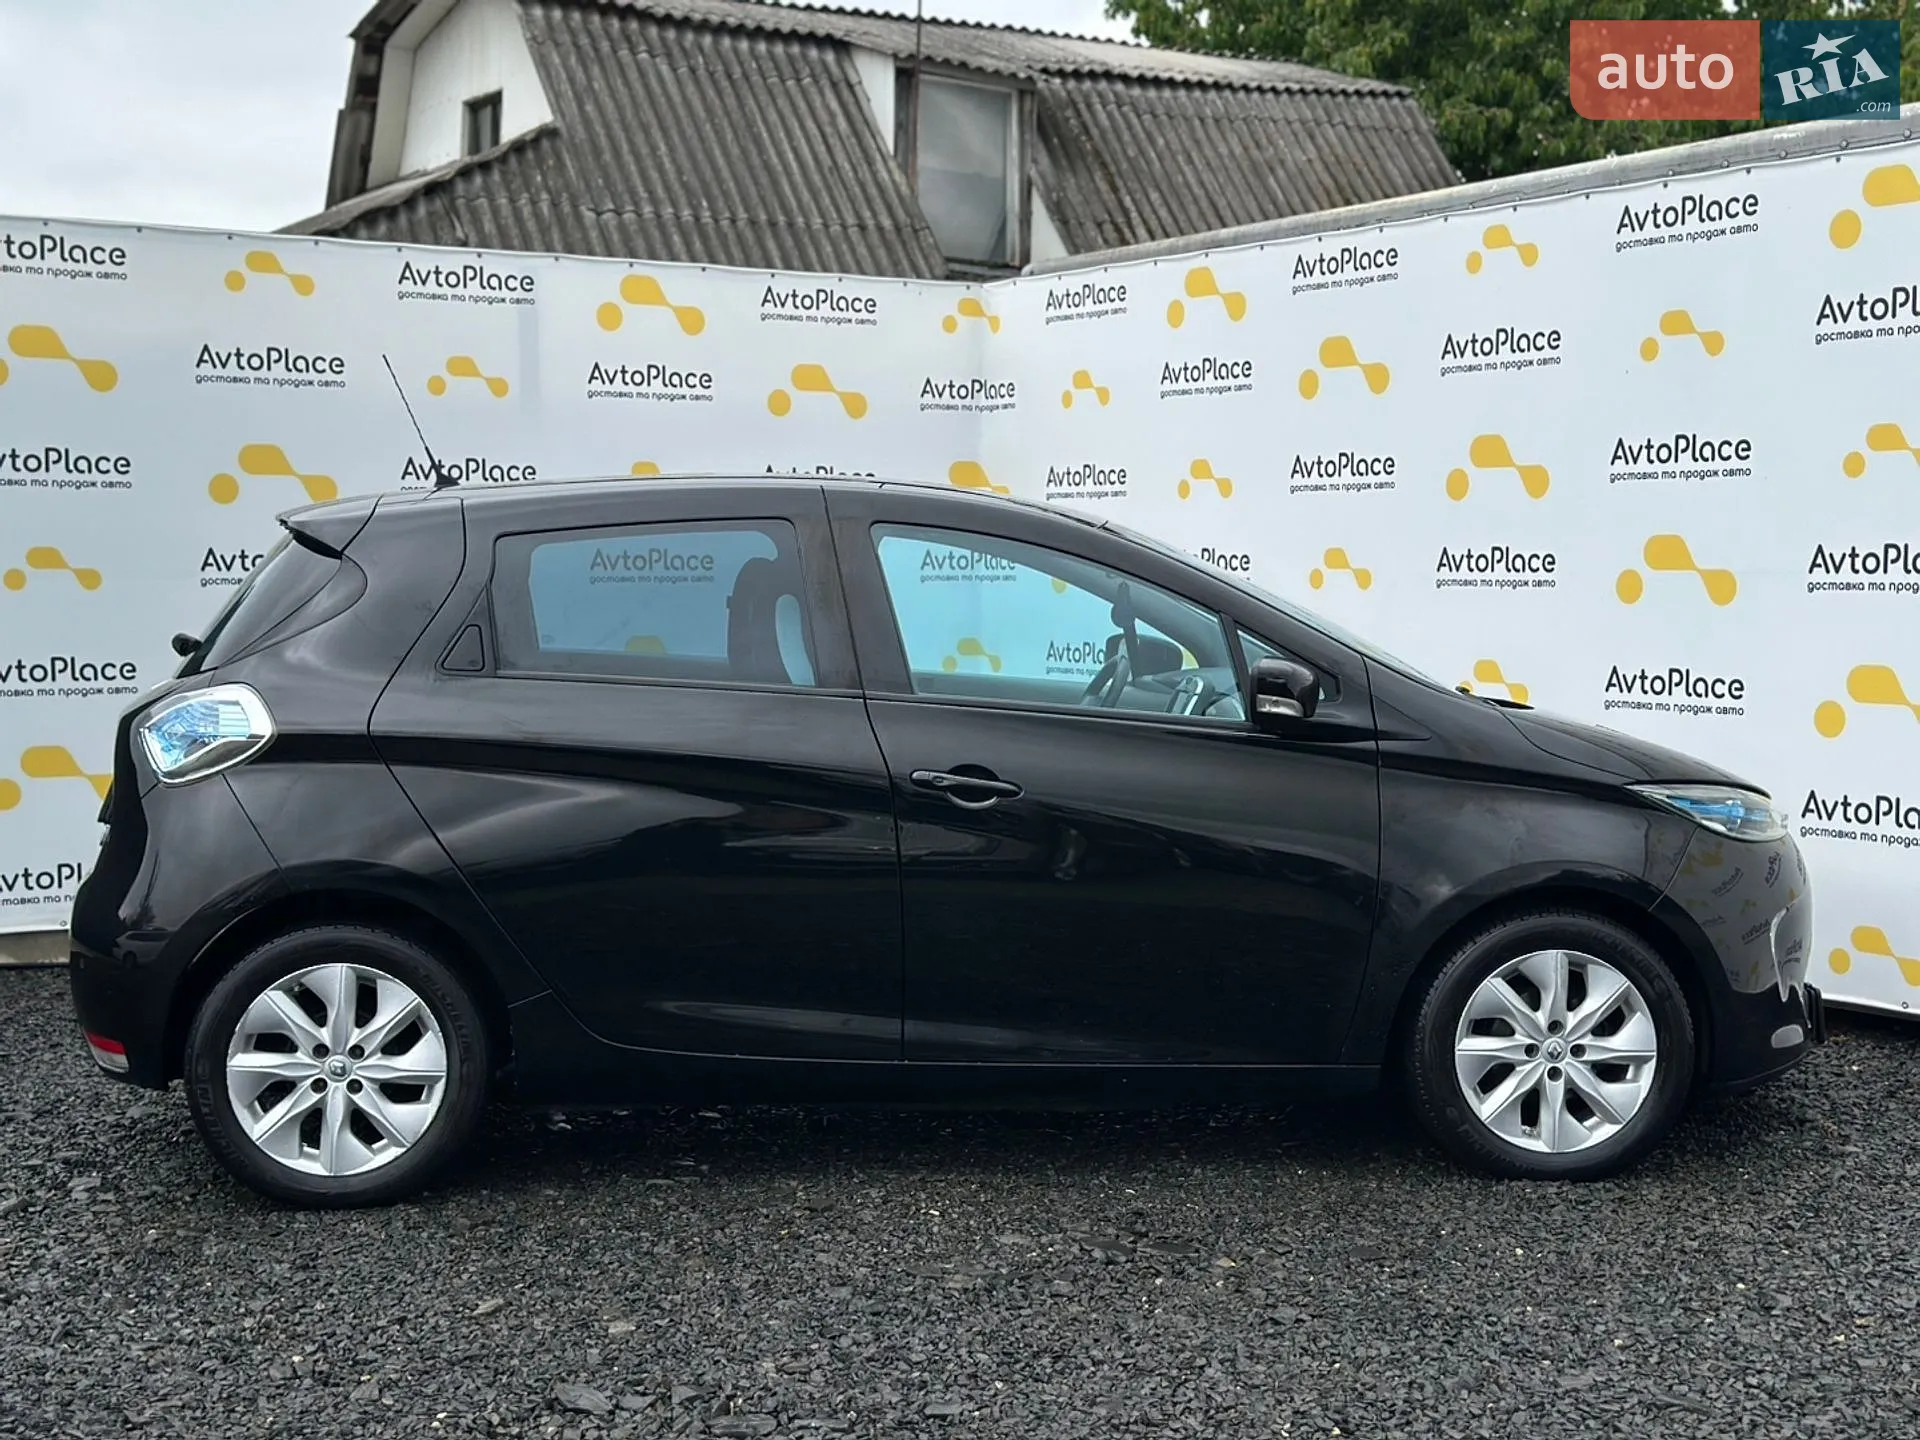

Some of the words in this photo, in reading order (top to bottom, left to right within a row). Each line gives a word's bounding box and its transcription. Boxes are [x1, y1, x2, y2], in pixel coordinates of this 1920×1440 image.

[1616, 193, 1759, 235] AvtoPlace
[0, 234, 127, 266] toPlace
[1292, 246, 1398, 280] AvtoPlace
[398, 261, 535, 293] AvtoPlace
[761, 285, 877, 314] AvtoPlace
[1046, 283, 1126, 312] AvtoPlace
[1441, 326, 1561, 360] AvtoPlace
[195, 343, 346, 375] AvtoPlace
[1160, 357, 1252, 385] AvtoPlace
[588, 361, 713, 390] AvtoPlace
[920, 377, 1015, 400] AvtoPlace
[1610, 433, 1752, 466] AvtoPlace
[1046, 464, 1127, 488] AvtoPlace
[1291, 451, 1395, 480] AvtoPlace
[591, 548, 714, 572] AvtoPlace
[1436, 546, 1556, 573] AvtoPlace
[1605, 665, 1745, 700] AvtoPlace
[1881, 834, 1920, 849] прода
[0, 862, 82, 892] vtoPl
